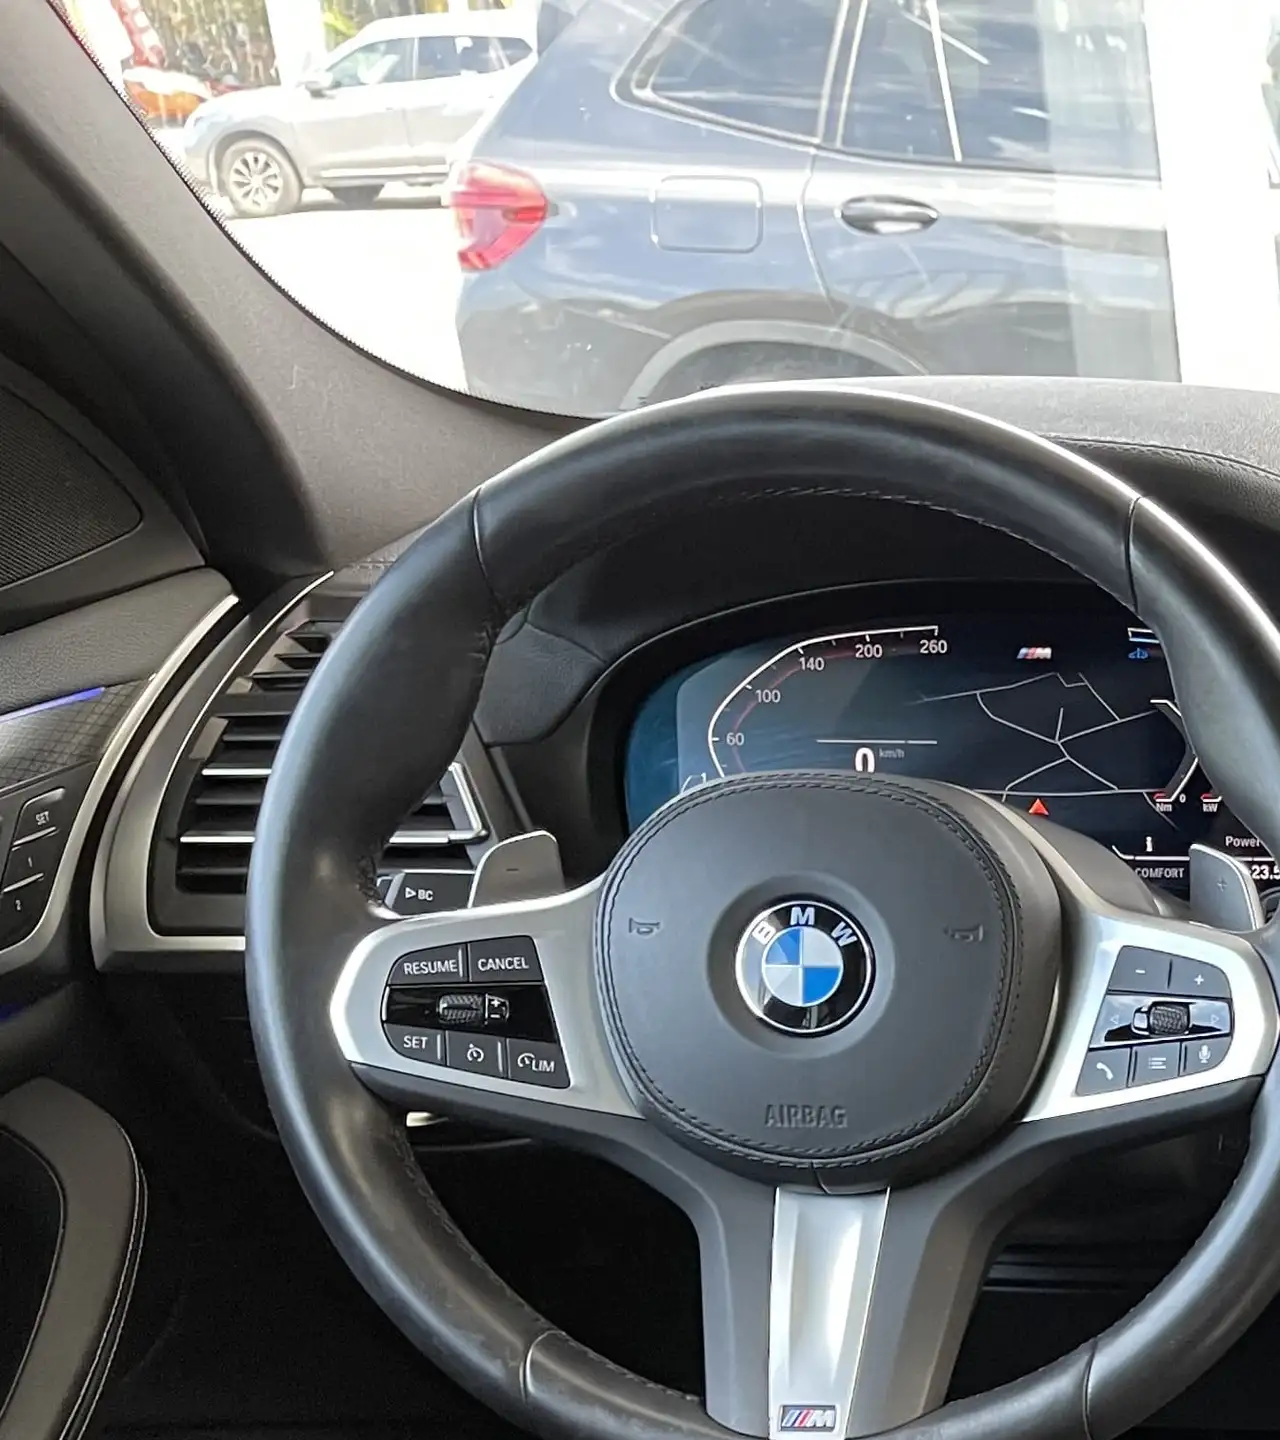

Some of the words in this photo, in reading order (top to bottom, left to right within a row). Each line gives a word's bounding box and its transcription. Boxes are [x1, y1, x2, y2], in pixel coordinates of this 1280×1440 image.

[854, 644, 883, 659] 200
[919, 639, 948, 654] 260
[799, 657, 825, 671] 140
[755, 689, 781, 703] 100
[726, 732, 745, 746] 60
[1156, 803, 1173, 813] Nm
[1202, 803, 1218, 813] kW
[1225, 835, 1261, 848] Power
[1134, 867, 1185, 878] COMFORT
[418, 889, 434, 901] BC
[752, 906, 858, 948] BMW
[403, 959, 459, 975] RESUME
[477, 956, 530, 972] CANCEL
[403, 1035, 428, 1049] SET
[531, 1058, 556, 1073] LIM
[764, 1104, 848, 1129] AIRBAG
